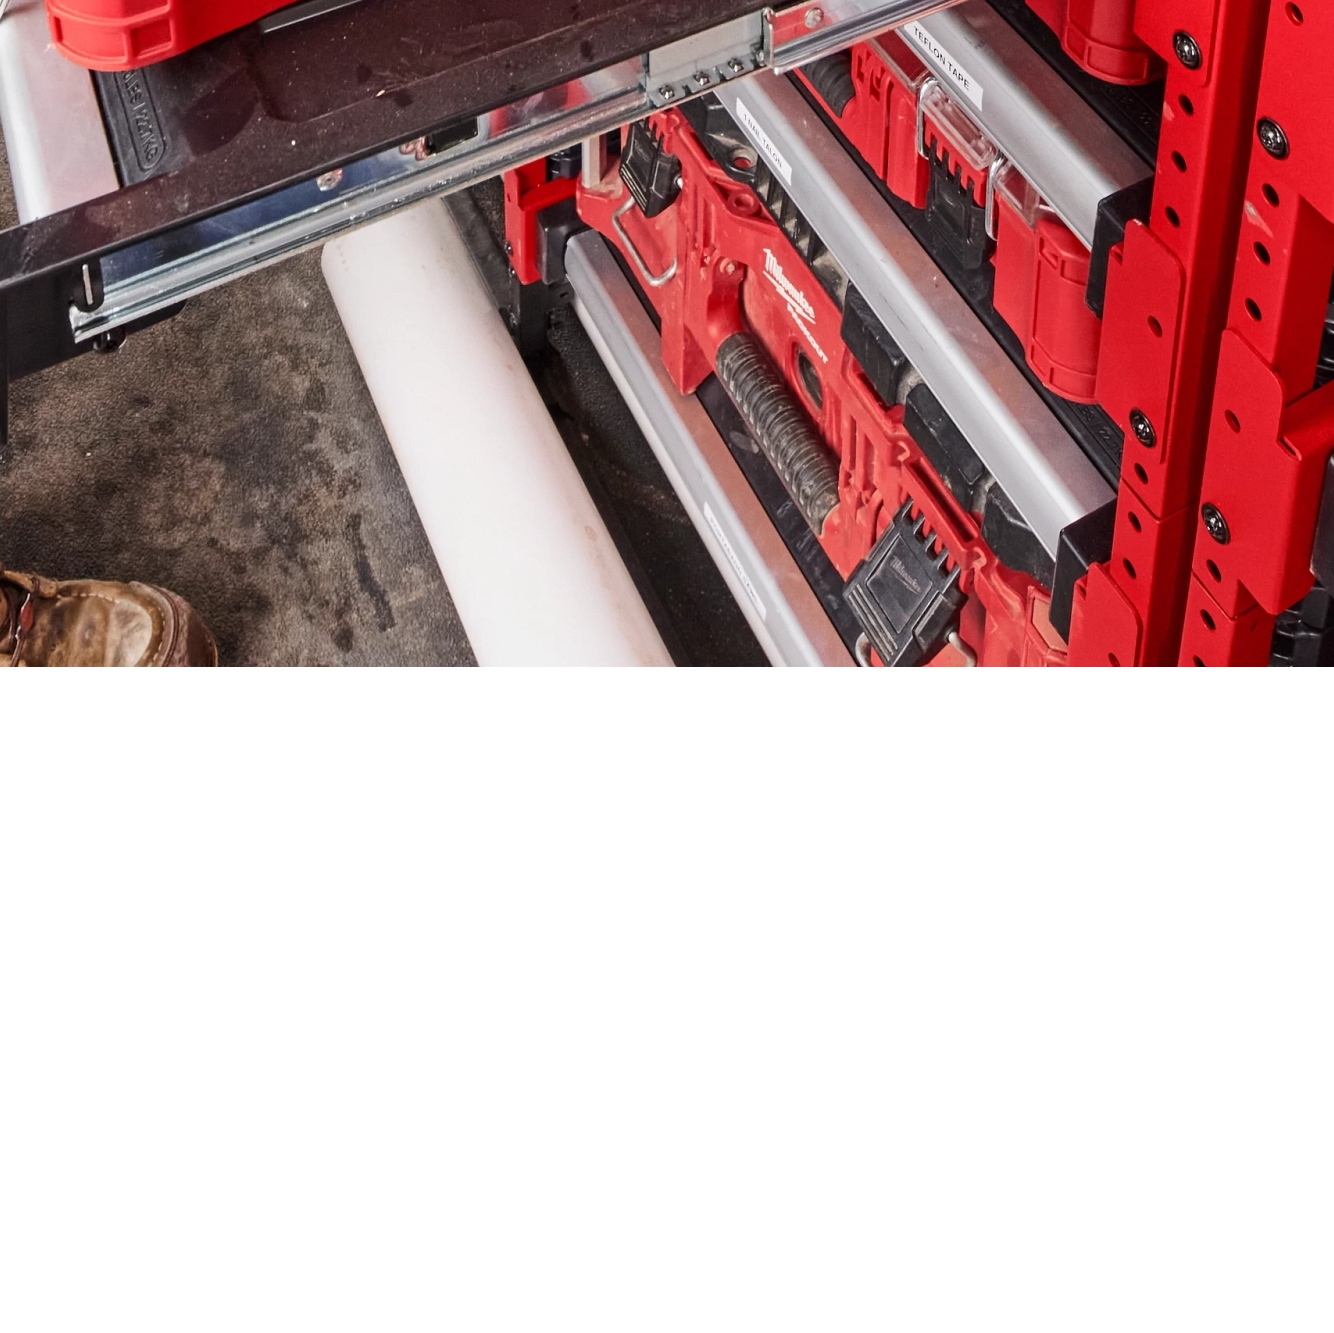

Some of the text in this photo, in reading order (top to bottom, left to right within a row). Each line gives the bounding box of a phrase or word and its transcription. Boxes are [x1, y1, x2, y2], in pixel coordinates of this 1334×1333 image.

[913, 25, 970, 91] TEFLON TAPE
[763, 138, 783, 169] TALON
[762, 247, 816, 319] Milwaukee
[787, 302, 829, 364] PACKOUT
